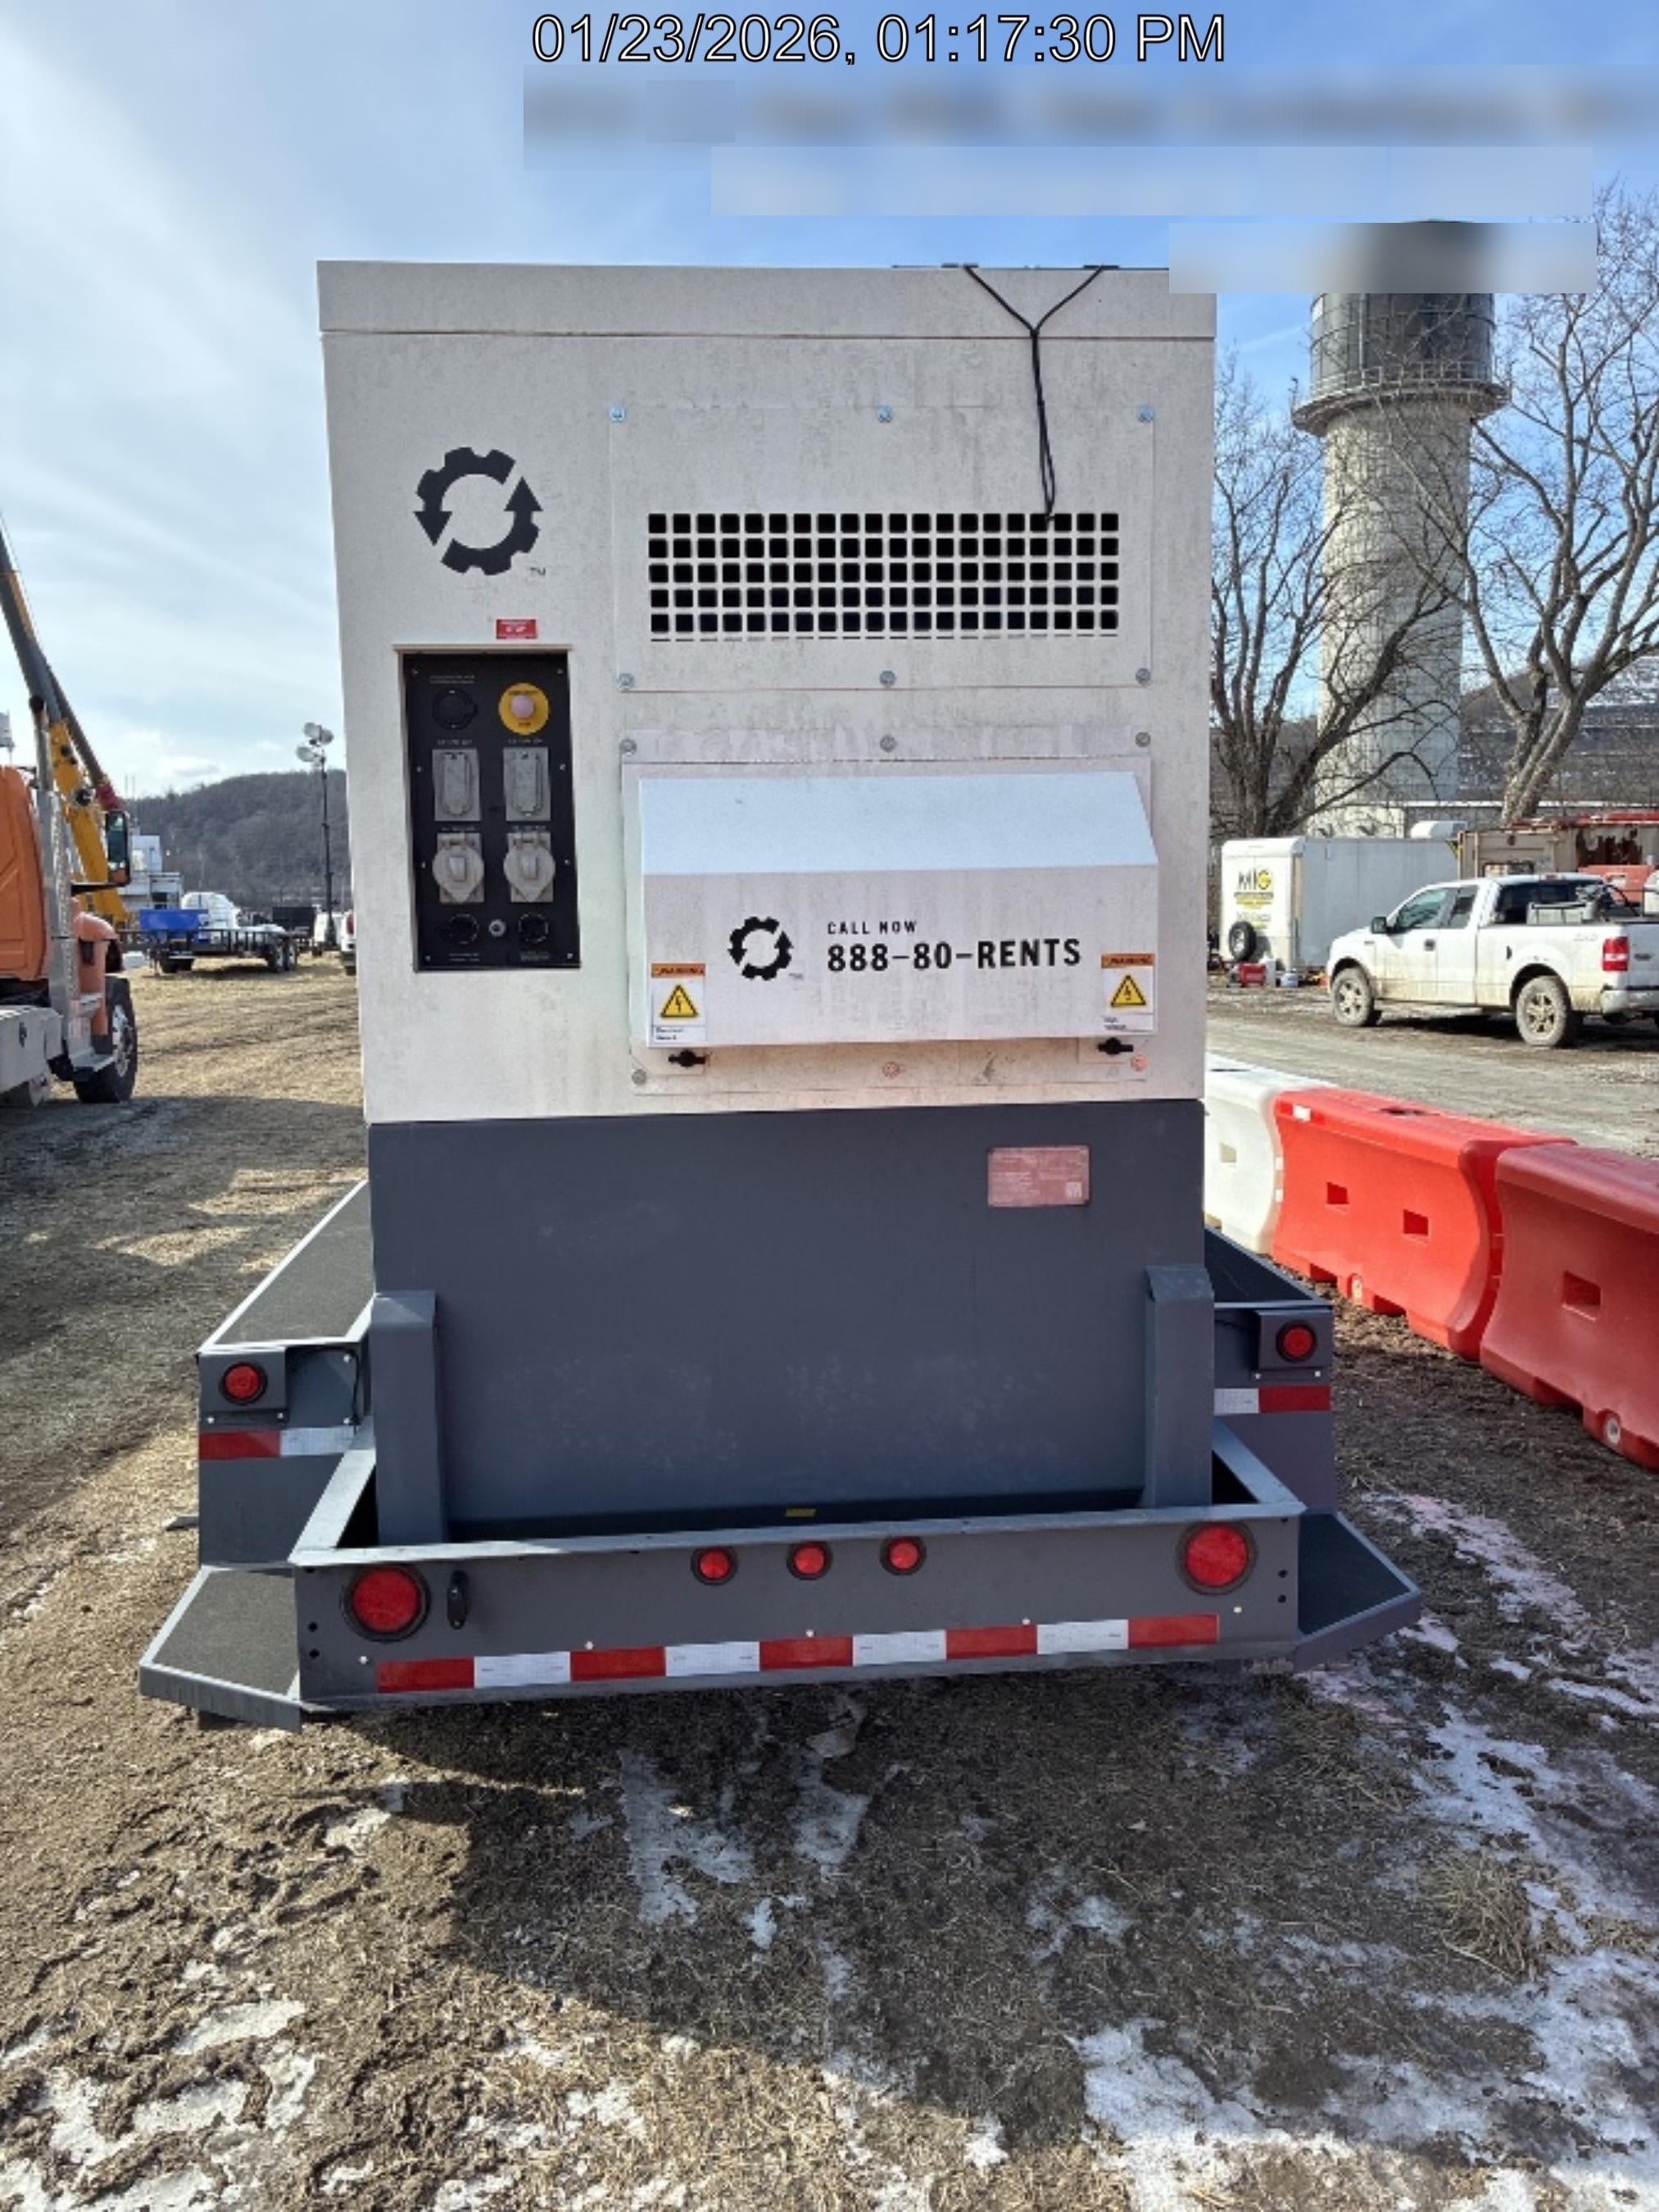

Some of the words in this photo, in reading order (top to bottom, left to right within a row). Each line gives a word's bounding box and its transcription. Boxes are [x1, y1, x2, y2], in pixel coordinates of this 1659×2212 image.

[827, 921, 870, 934] CALL
[879, 920, 916, 933] NOW
[827, 938, 1081, 971] 888-80-RENTS
